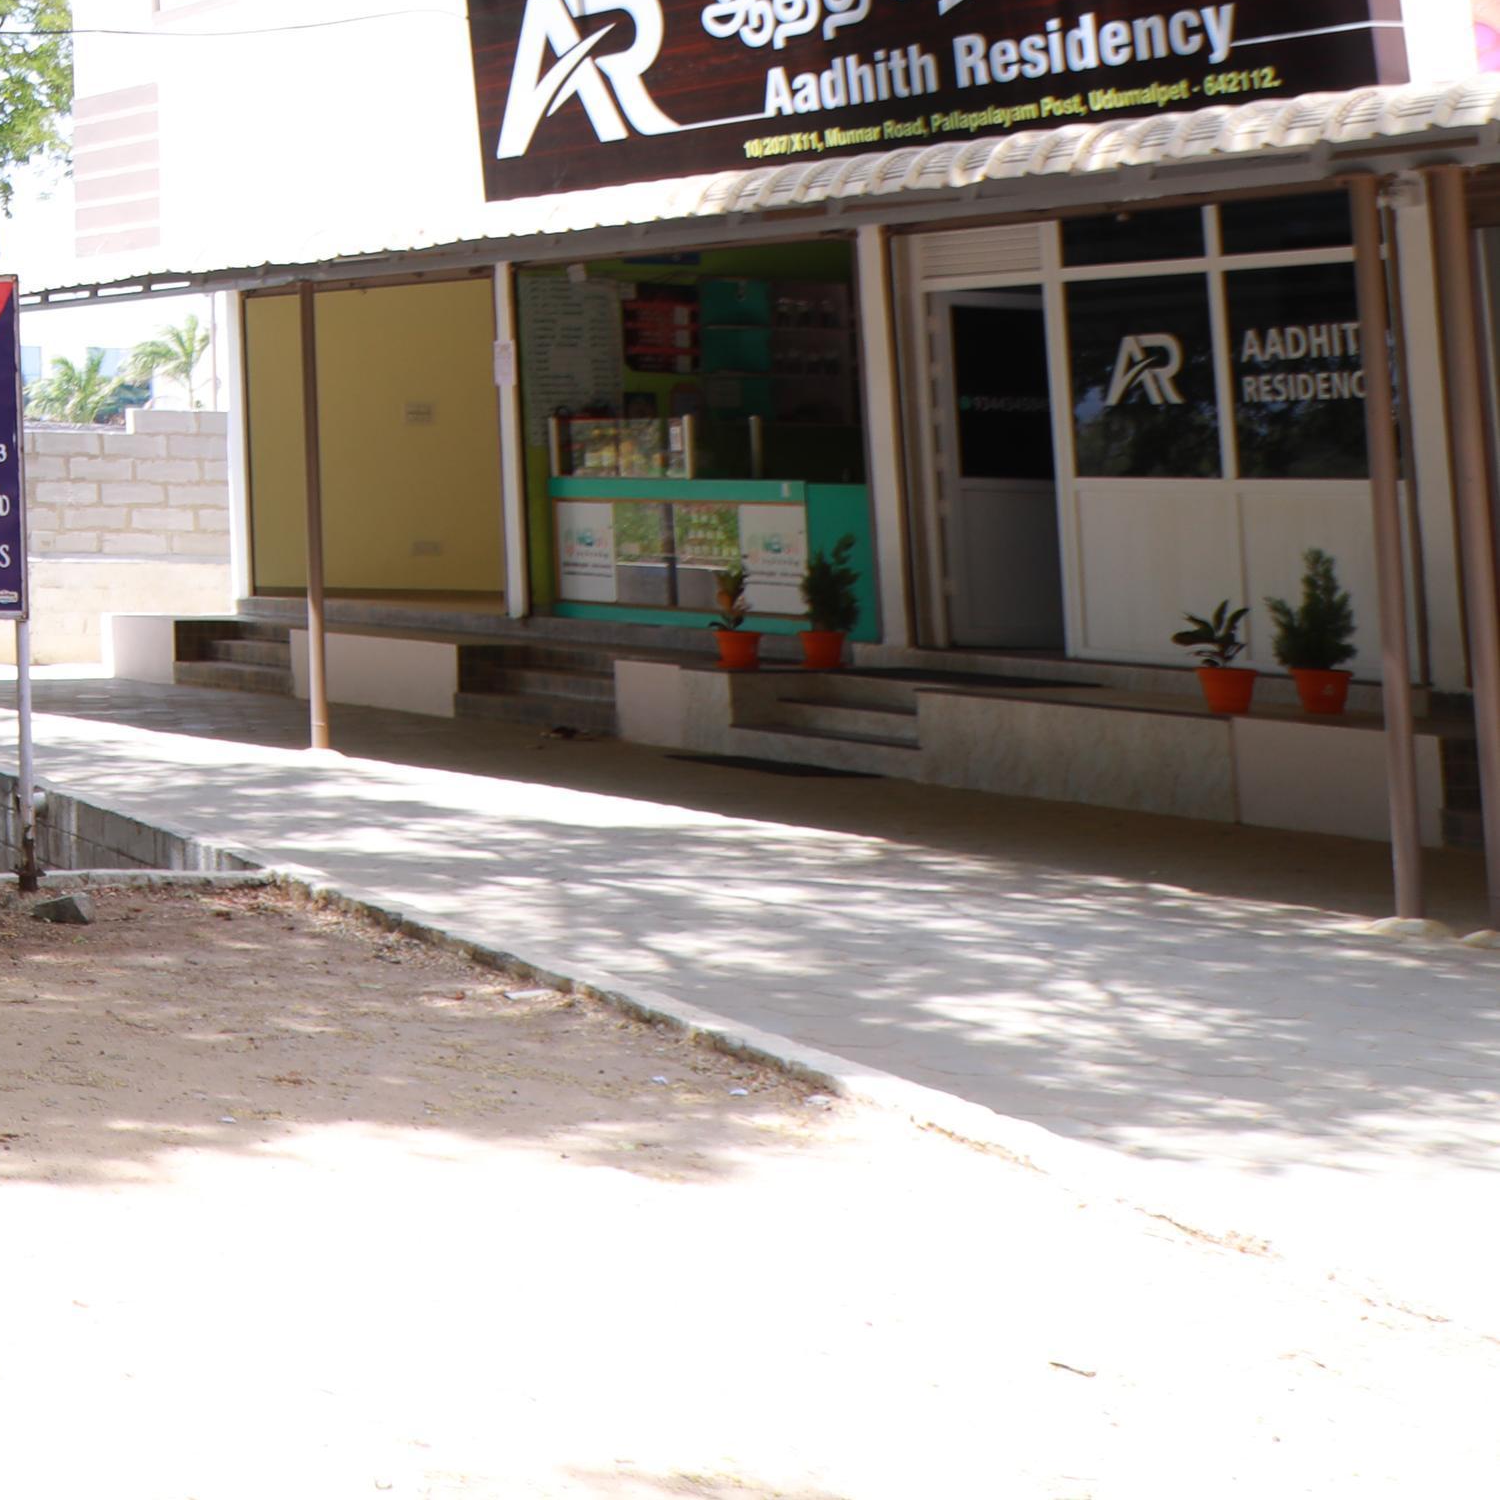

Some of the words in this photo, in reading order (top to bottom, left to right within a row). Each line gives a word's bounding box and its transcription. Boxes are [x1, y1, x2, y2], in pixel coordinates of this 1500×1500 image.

[764, 43, 940, 117] Aadhith
[953, 3, 1236, 89] Residency
[824, 125, 881, 148] Munnar
[883, 116, 929, 139] Road,
[931, 101, 1038, 133] Pallapalayam
[1041, 92, 1087, 117] Post,
[1088, 79, 1190, 112] Udumalpet
[1241, 322, 1361, 363] AADHIT
[1243, 370, 1367, 403] RESIDENC
